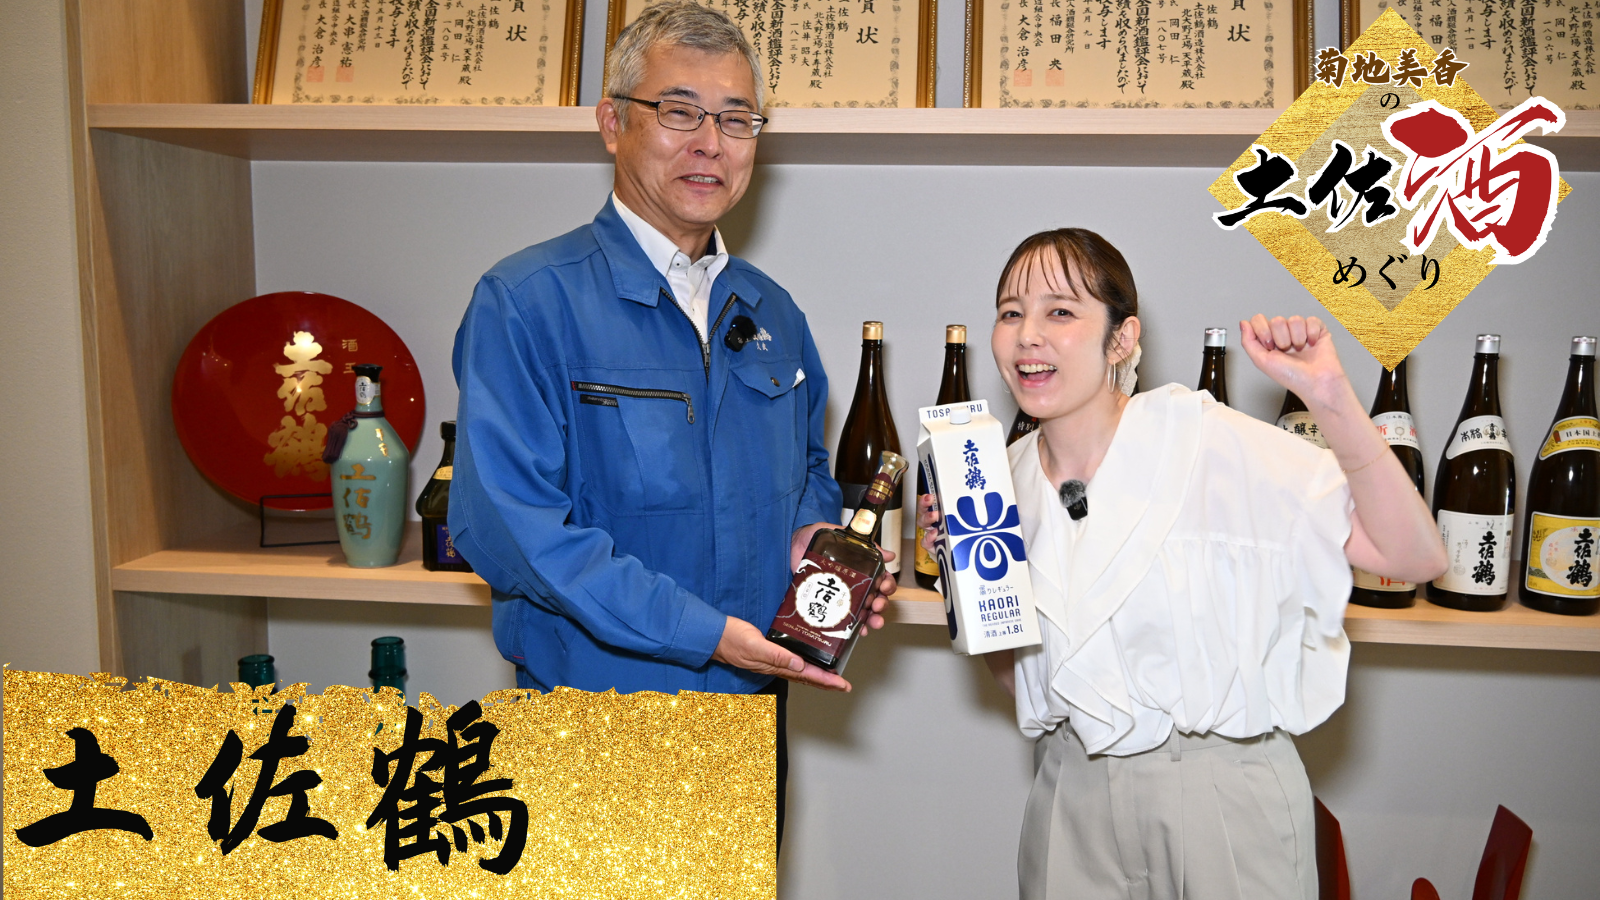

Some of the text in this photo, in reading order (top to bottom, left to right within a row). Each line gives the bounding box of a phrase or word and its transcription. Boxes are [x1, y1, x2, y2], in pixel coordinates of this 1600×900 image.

[488, 0, 500, 29] 佐鶴
[837, 0, 849, 32] 佐鶴
[963, 439, 987, 490] 土佐鶴
[340, 463, 377, 540] 土佐鶴
[1471, 530, 1498, 586] 土佐鶴
[1566, 528, 1595, 588] 土佐鶴
[807, 577, 841, 623] 土佐鶴
[978, 594, 1019, 613] KAORI
[980, 608, 1022, 622] REGULAR
